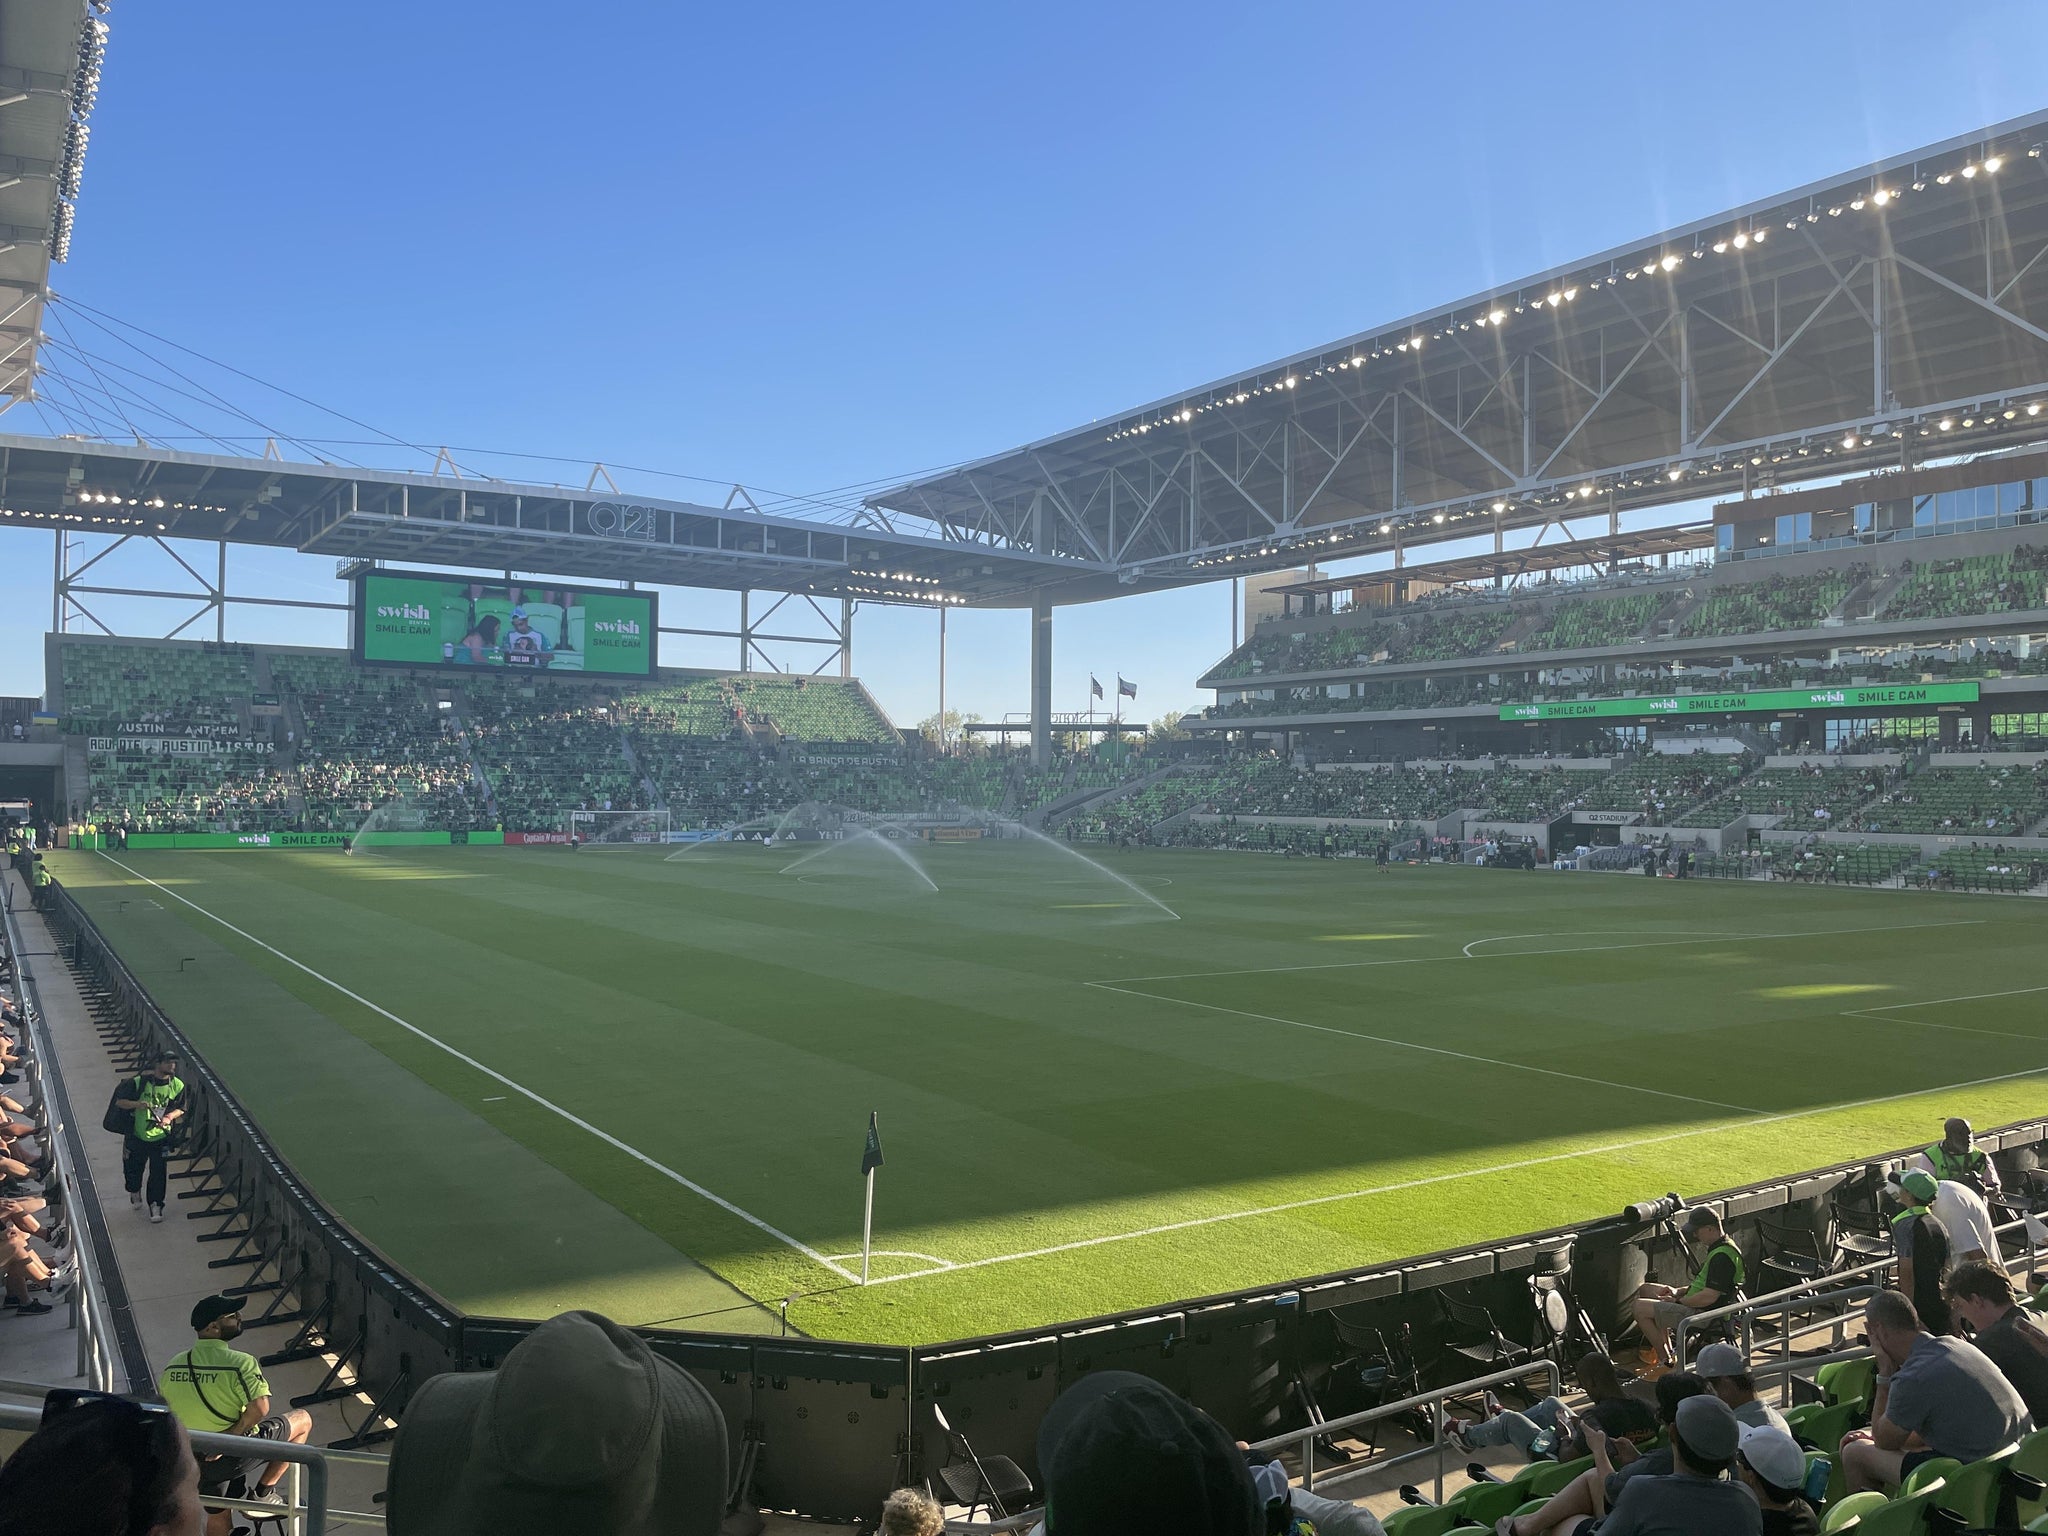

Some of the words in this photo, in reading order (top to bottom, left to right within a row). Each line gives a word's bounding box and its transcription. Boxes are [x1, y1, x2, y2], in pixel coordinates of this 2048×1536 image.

[587, 502, 648, 539] Q2
[377, 603, 430, 619] swish
[375, 624, 406, 634] SMILE
[594, 619, 640, 634] swish
[592, 638, 619, 648] SMILE
[621, 640, 641, 649] CAM
[1810, 691, 1845, 703] swish
[1858, 691, 1895, 703] SMILE
[1899, 690, 1927, 701] CAM
[1650, 699, 1678, 710] swish
[1689, 700, 1720, 710] SMILE
[1723, 698, 1747, 708] CAM
[1514, 706, 1539, 716] swish
[1548, 707, 1574, 716] SMILE
[1576, 706, 1596, 715] CAM
[117, 723, 165, 733] AUSTIN
[162, 741, 211, 752] AUSTIN
[238, 833, 271, 843] swish
[281, 835, 317, 844] SMILE
[320, 835, 346, 844] CAM
[523, 833, 546, 844] Captain
[818, 829, 844, 839] YETI
[888, 830, 899, 838] Q2
